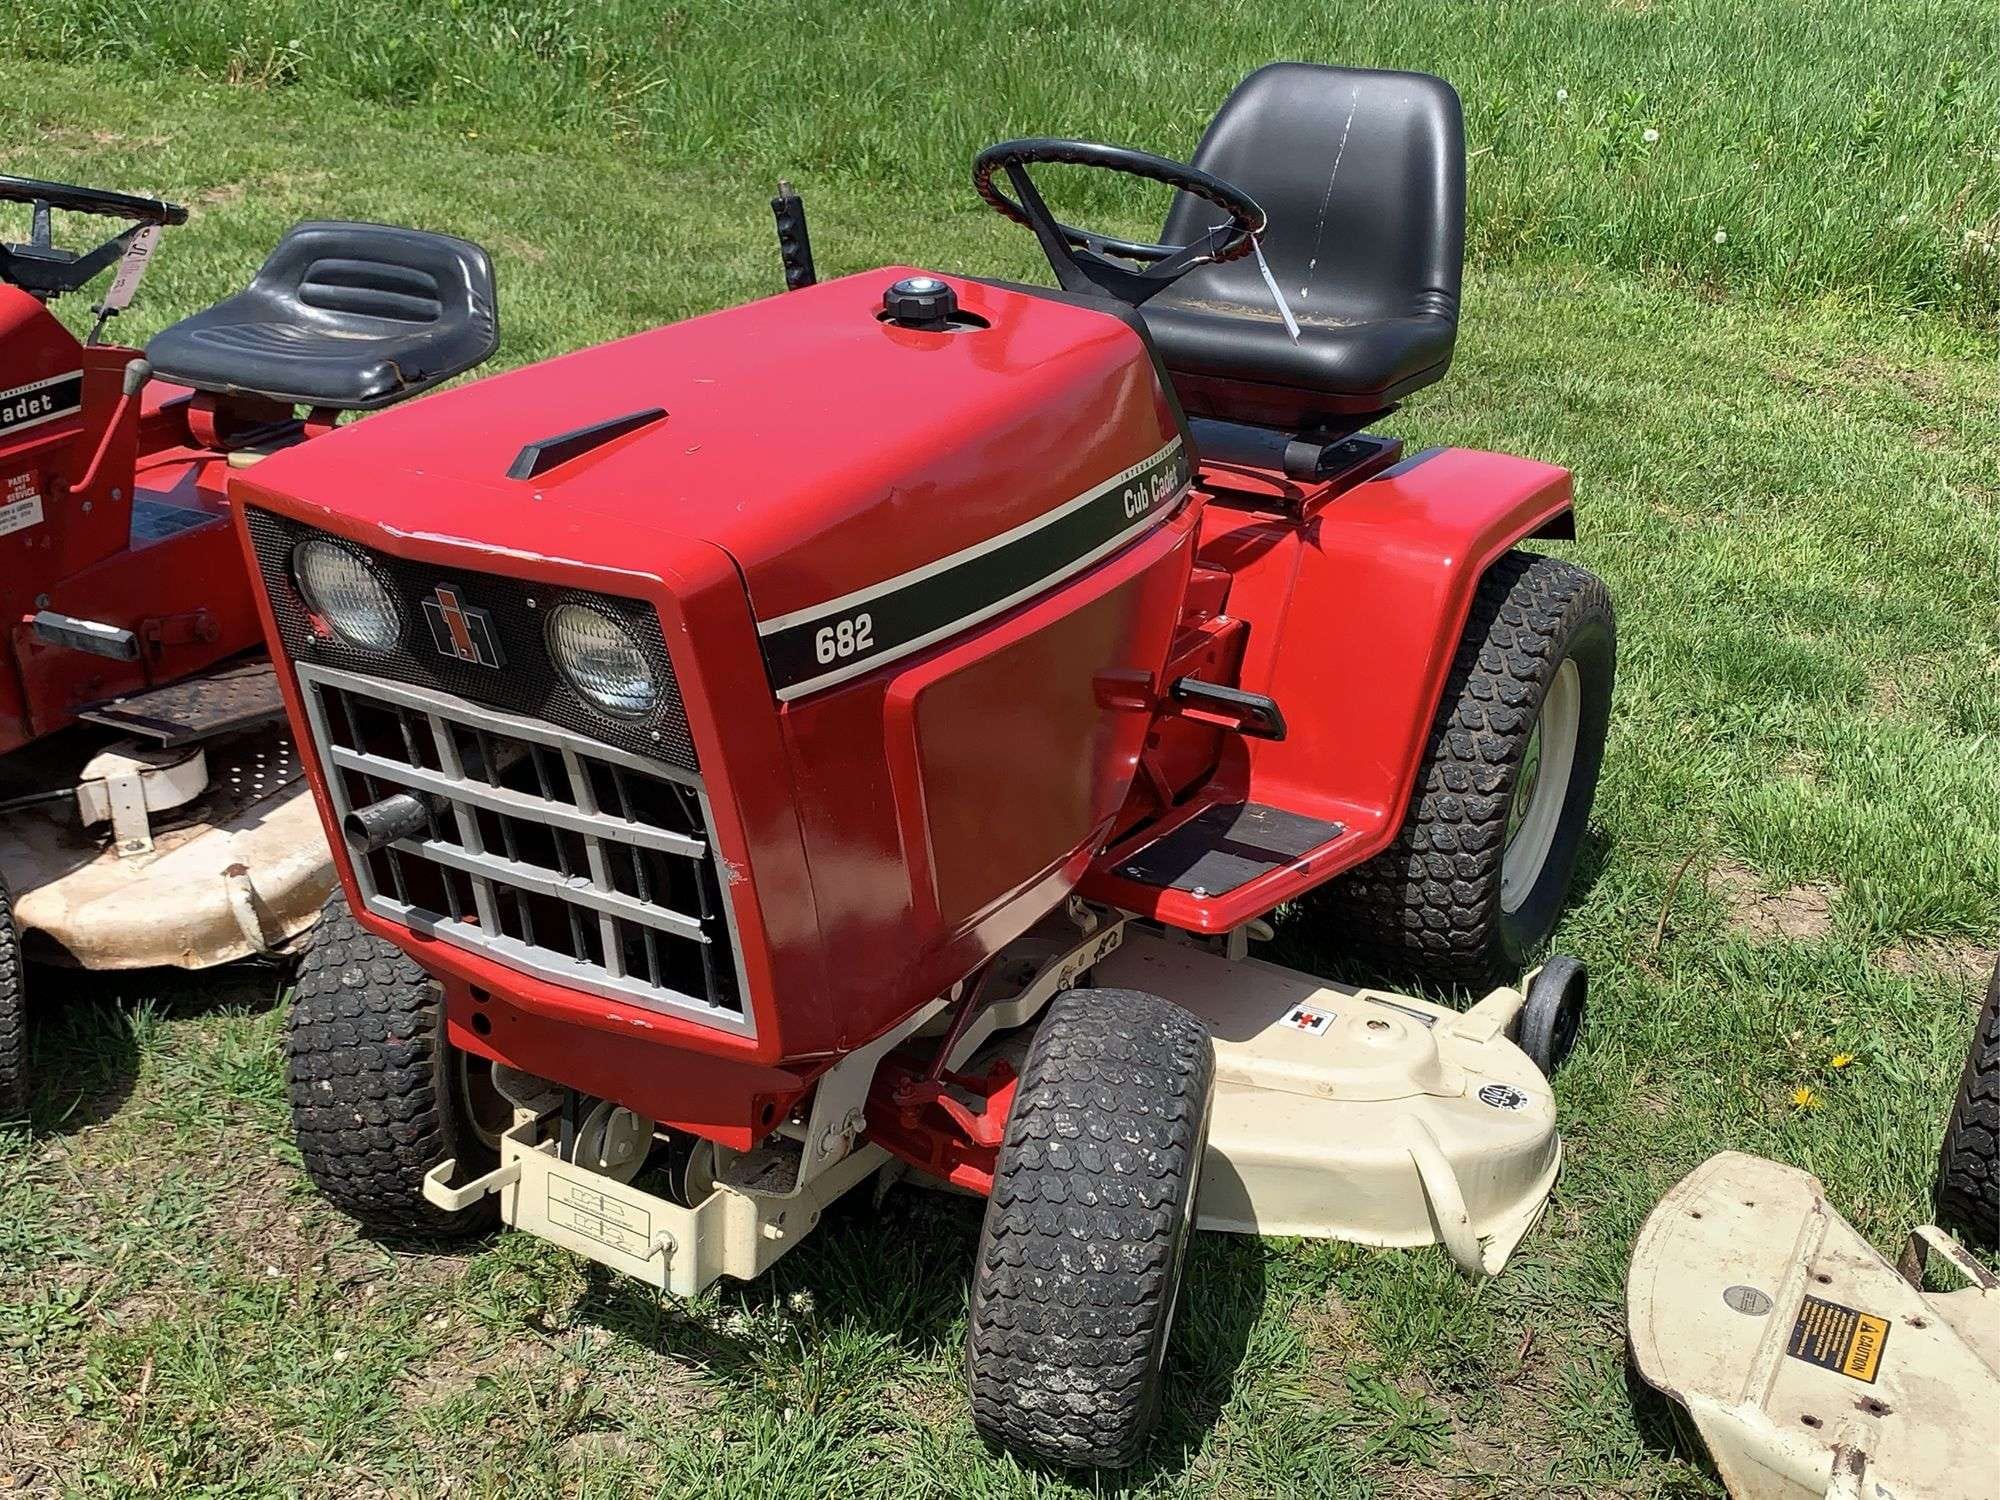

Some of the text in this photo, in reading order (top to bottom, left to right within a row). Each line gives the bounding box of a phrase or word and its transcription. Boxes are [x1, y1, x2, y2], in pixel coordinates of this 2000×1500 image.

[0, 395, 52, 423] adet
[6, 487, 35, 502] SERVICE
[1124, 464, 1178, 518] Cub Cadet
[815, 613, 874, 665] 682
[1851, 1335, 1874, 1373] CAUTION
